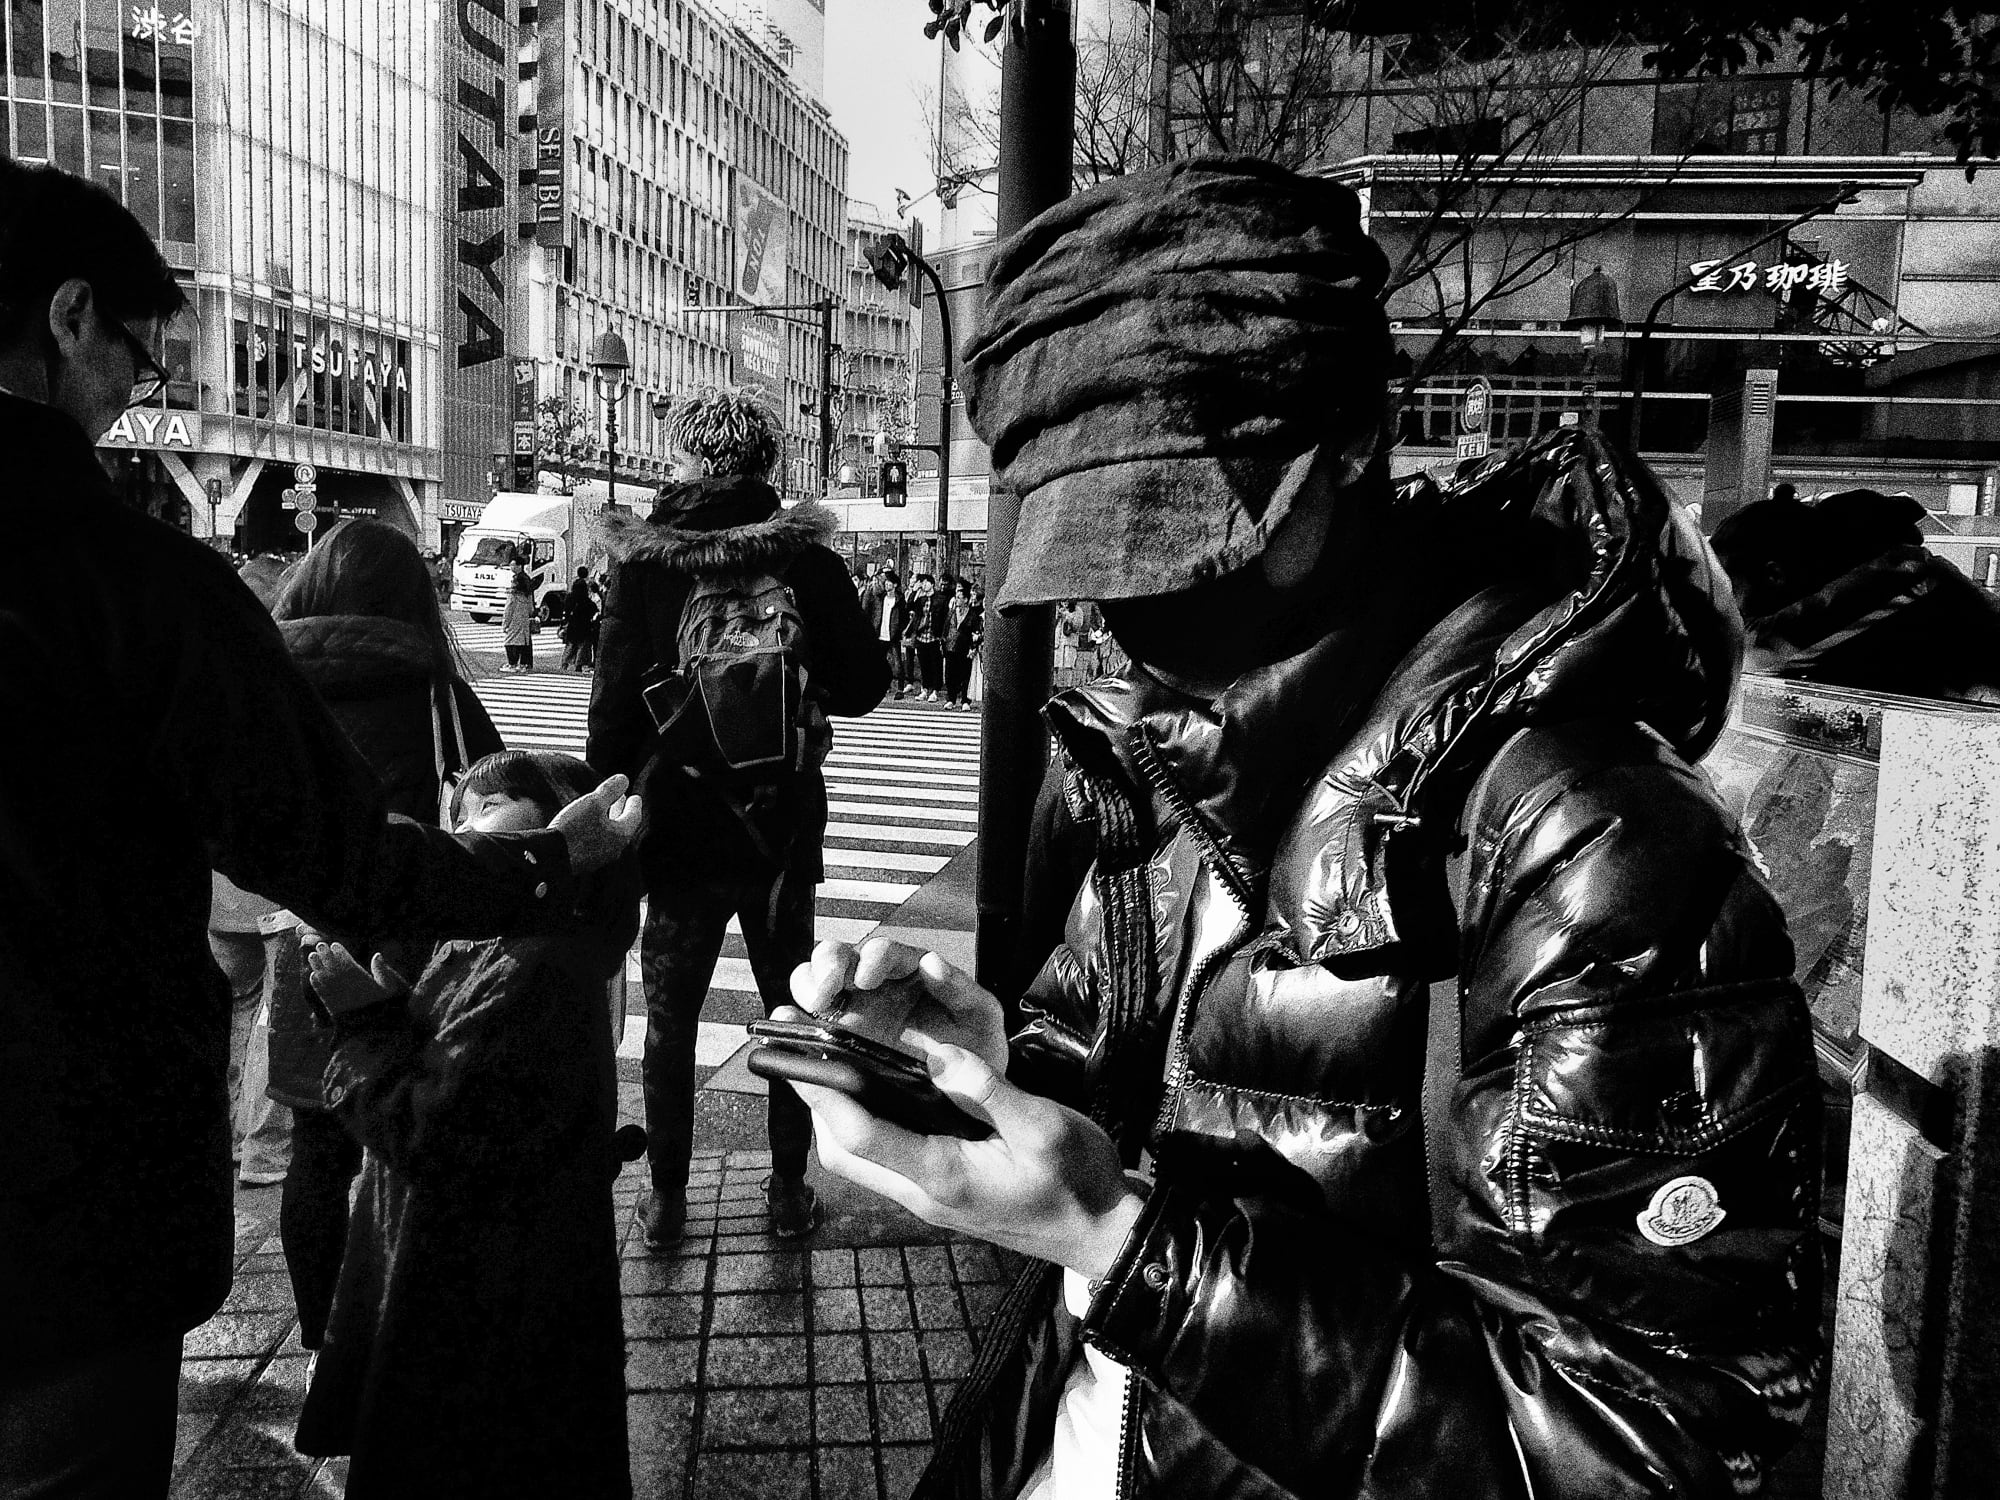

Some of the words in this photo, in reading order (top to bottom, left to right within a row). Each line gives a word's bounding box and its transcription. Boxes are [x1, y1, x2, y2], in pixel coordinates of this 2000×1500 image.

[131, 5, 201, 44] 渋谷
[538, 128, 561, 223] SEIBU
[1689, 259, 1851, 295] 星乃珈琲
[293, 342, 407, 392] TSUTAYA
[445, 503, 483, 517] TSUTAYA
